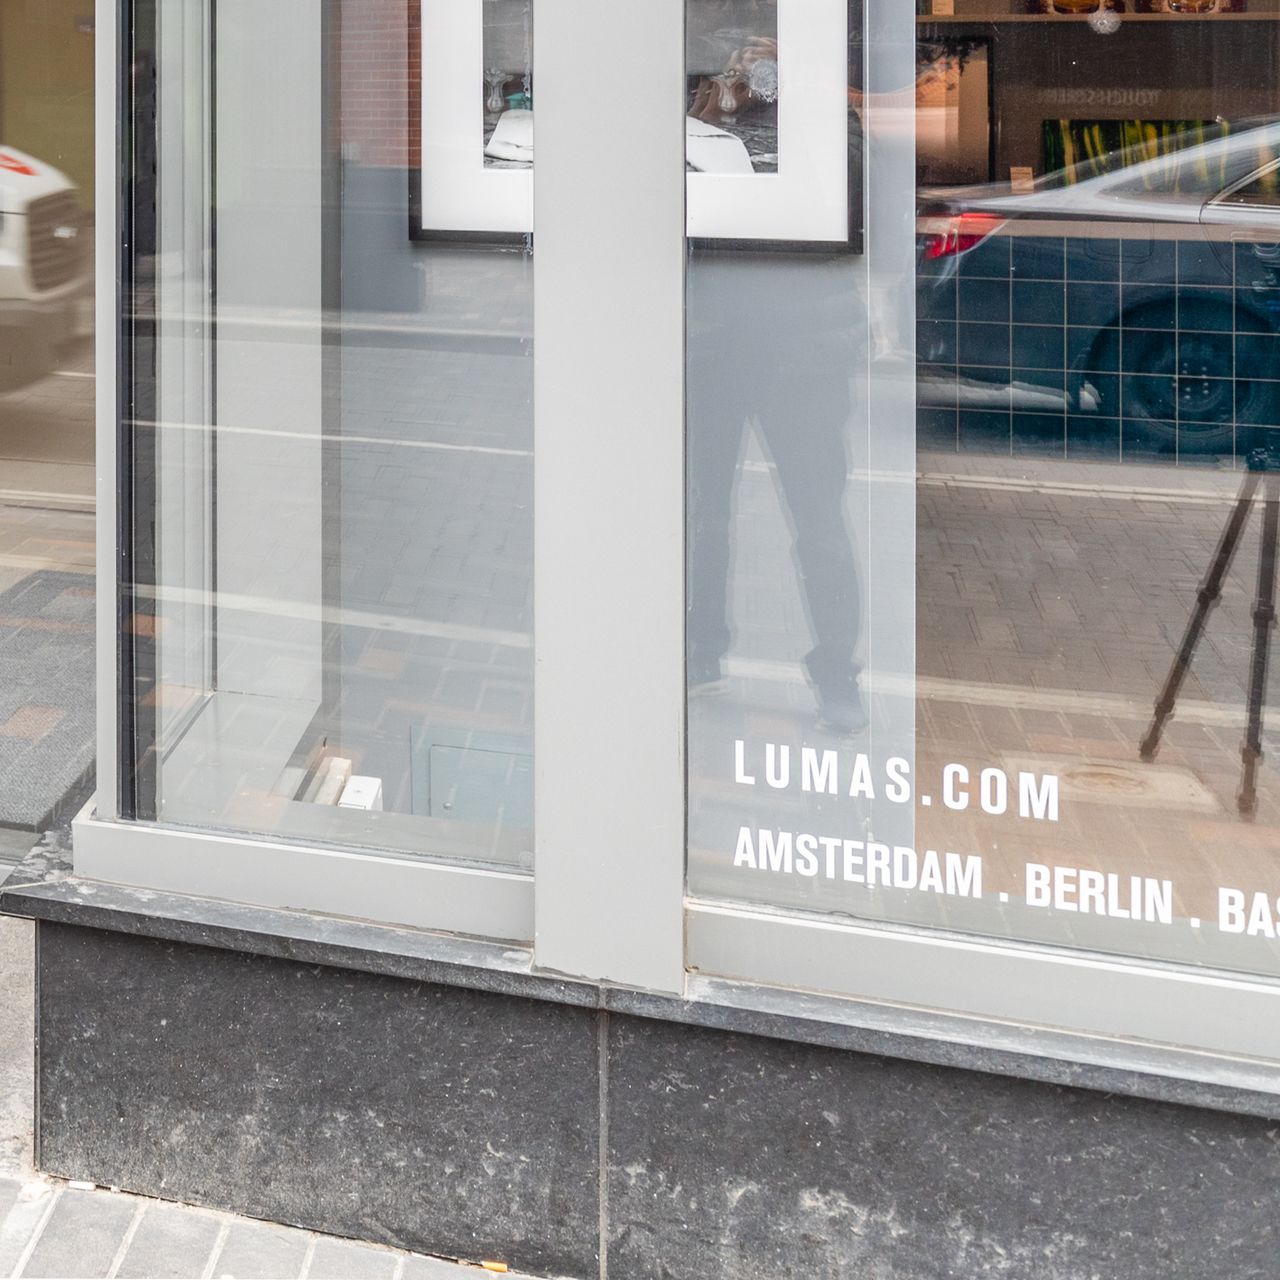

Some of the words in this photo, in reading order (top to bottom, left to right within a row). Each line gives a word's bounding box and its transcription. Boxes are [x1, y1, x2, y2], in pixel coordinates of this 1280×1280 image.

[734, 739, 1060, 822] LUMAS.COM
[733, 826, 982, 899] AMSTERDAM
[1026, 863, 1173, 924] BERLIN
[1219, 887, 1280, 939] BA
